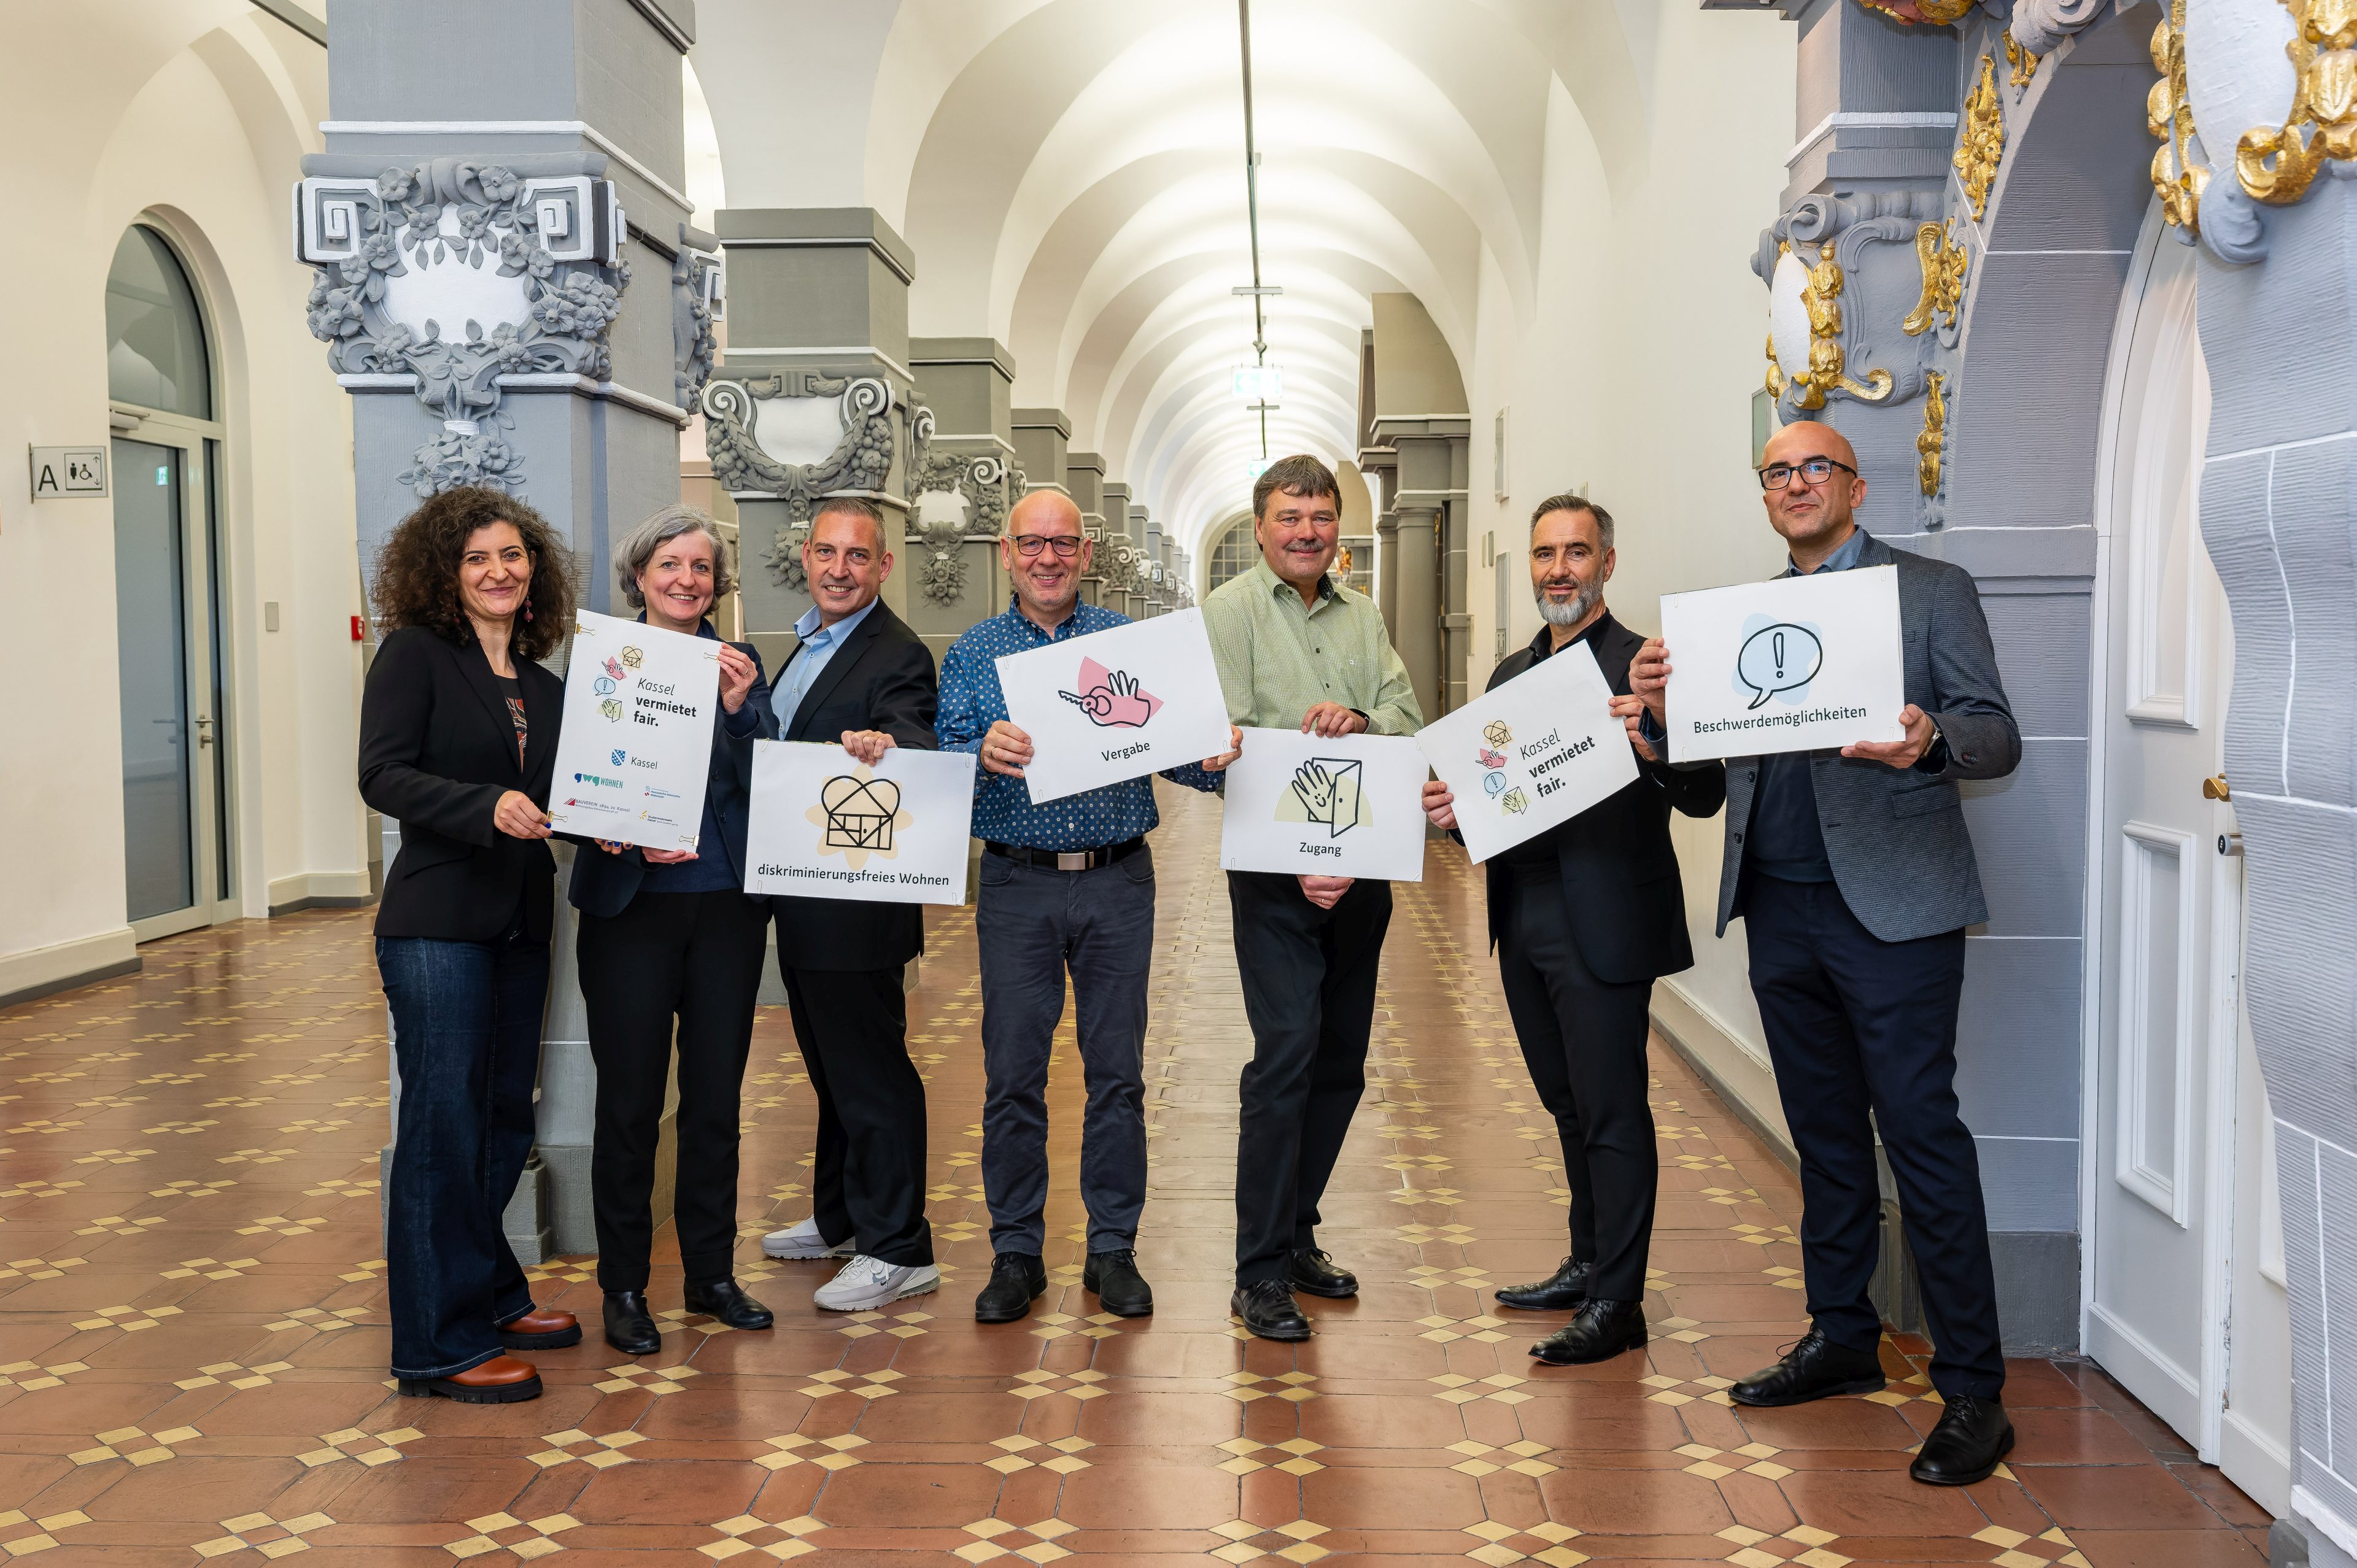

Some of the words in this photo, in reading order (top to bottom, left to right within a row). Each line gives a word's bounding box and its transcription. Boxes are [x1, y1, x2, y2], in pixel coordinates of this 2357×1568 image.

[38, 465, 58, 491] A
[638, 678, 675, 695] Kassel
[635, 697, 696, 717] vermietet
[634, 711, 659, 727] fair.
[1694, 706, 1867, 733] Beschwerdemöglichkeiten
[1101, 741, 1150, 762] Vergabe
[1520, 728, 1560, 760] Kassel
[631, 756, 658, 770] Kassel
[1529, 736, 1595, 778] vermietet
[600, 777, 624, 789] WOHNEN
[1537, 778, 1566, 797] fair.
[1299, 842, 1342, 857] Zugang
[758, 863, 896, 883] diskriminierungsfreies
[899, 873, 950, 886] Wohnen
